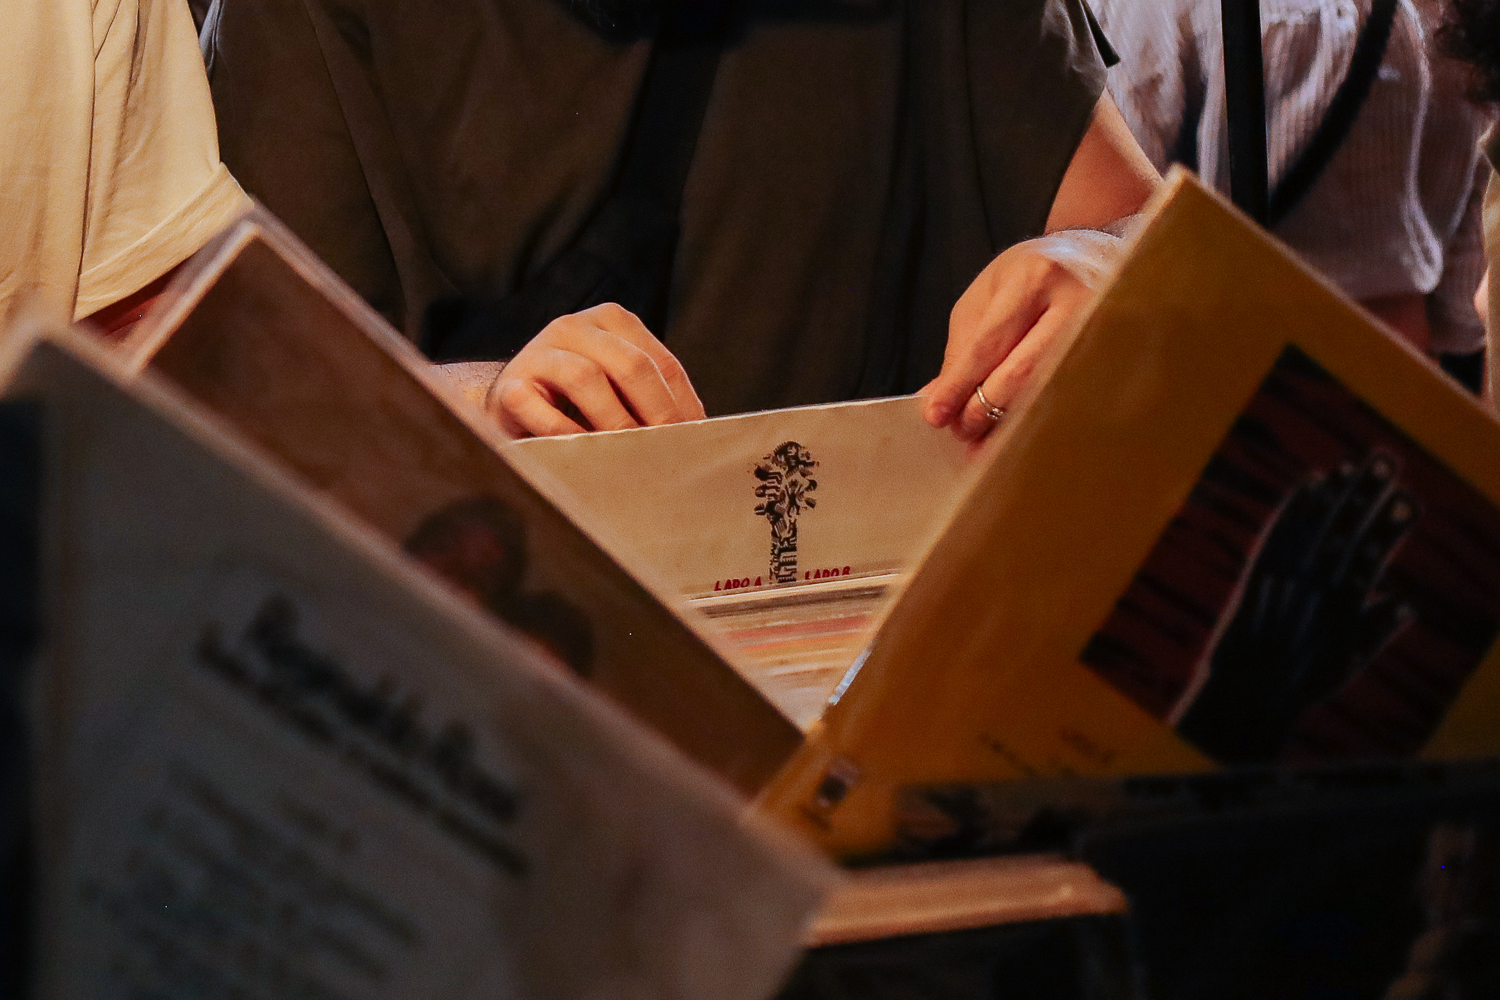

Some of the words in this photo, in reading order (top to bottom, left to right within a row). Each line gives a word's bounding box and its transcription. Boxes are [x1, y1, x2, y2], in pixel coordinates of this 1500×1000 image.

[804, 568, 840, 580] LADO
[714, 577, 750, 591] LADO
[755, 576, 762, 586] A
